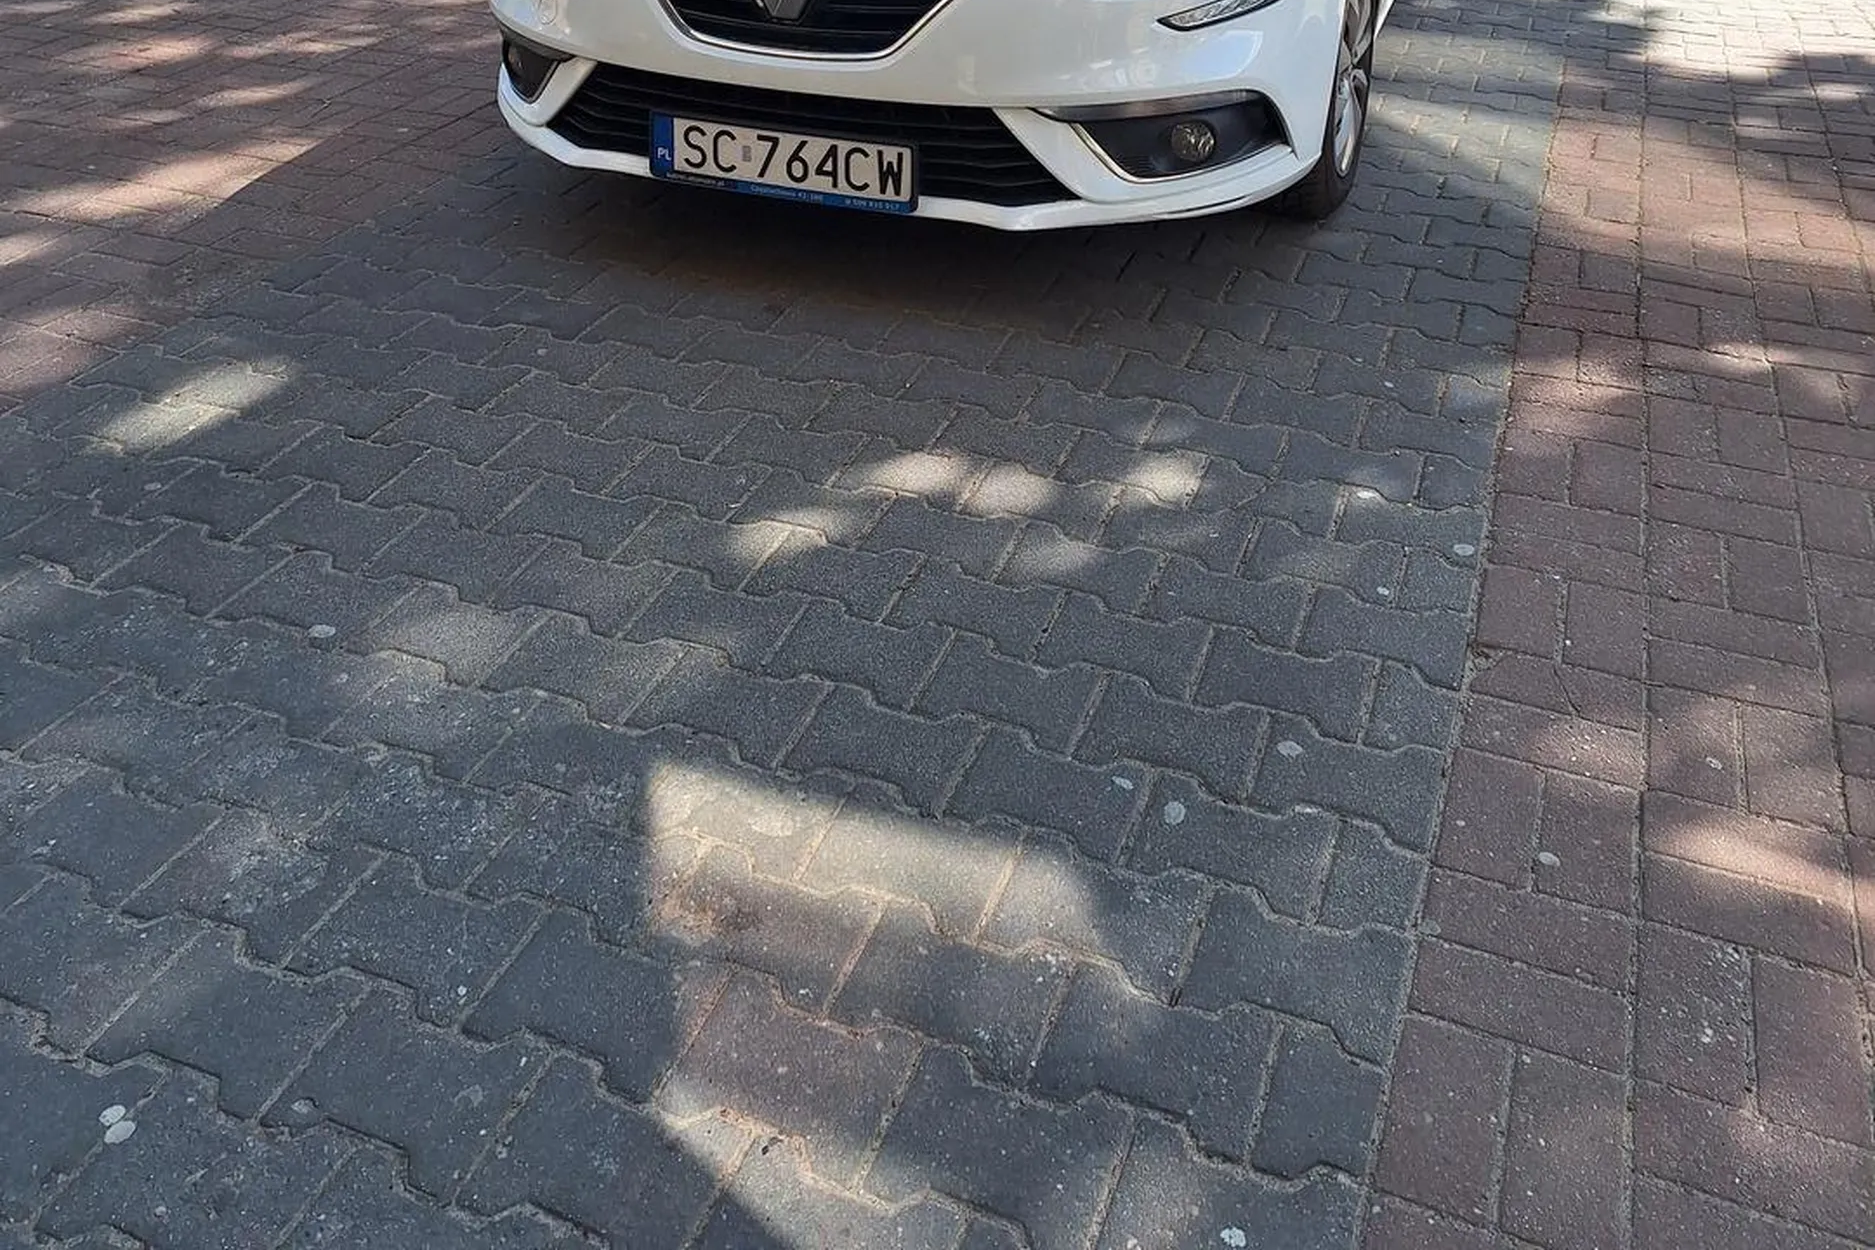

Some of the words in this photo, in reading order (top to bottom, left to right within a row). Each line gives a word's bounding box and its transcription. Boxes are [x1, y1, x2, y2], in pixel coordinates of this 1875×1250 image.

[657, 147, 672, 161] PL
[683, 125, 738, 173] SC
[756, 134, 904, 197] 764CW
